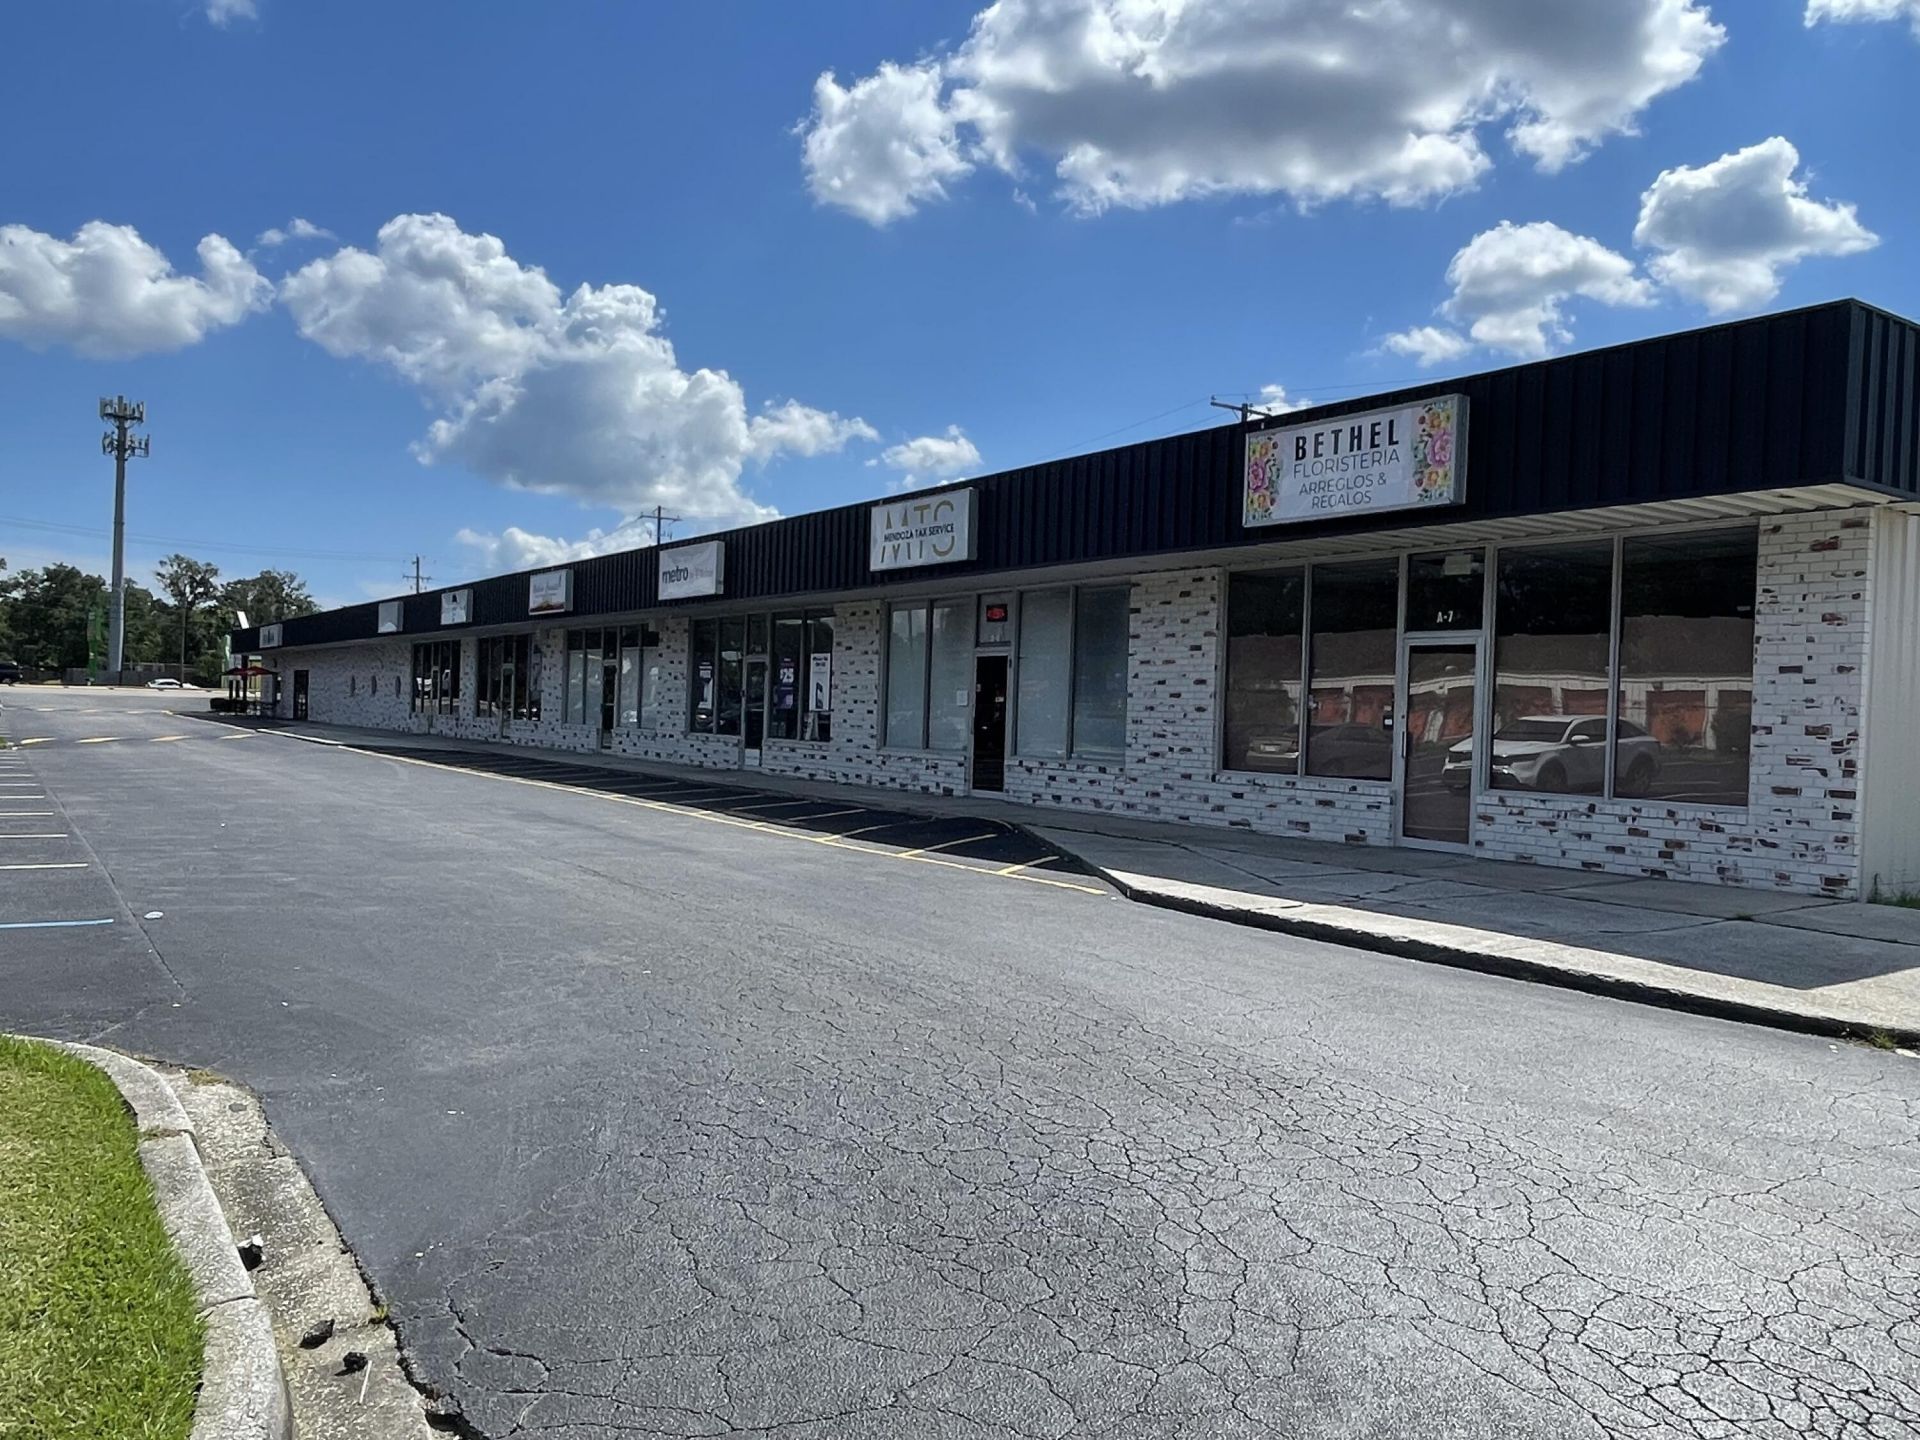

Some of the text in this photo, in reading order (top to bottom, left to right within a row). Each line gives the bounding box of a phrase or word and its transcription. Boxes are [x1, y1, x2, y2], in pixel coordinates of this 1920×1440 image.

[1294, 419, 1400, 462] BETHEL
[1293, 448, 1400, 480] FLORISTERIA
[1299, 472, 1387, 496] ARREGLOS &
[1311, 490, 1372, 509] REGALOS
[883, 523, 955, 543] MENDOZA TAX SERVICE
[662, 565, 689, 584] metro
[1436, 610, 1454, 624] A-7
